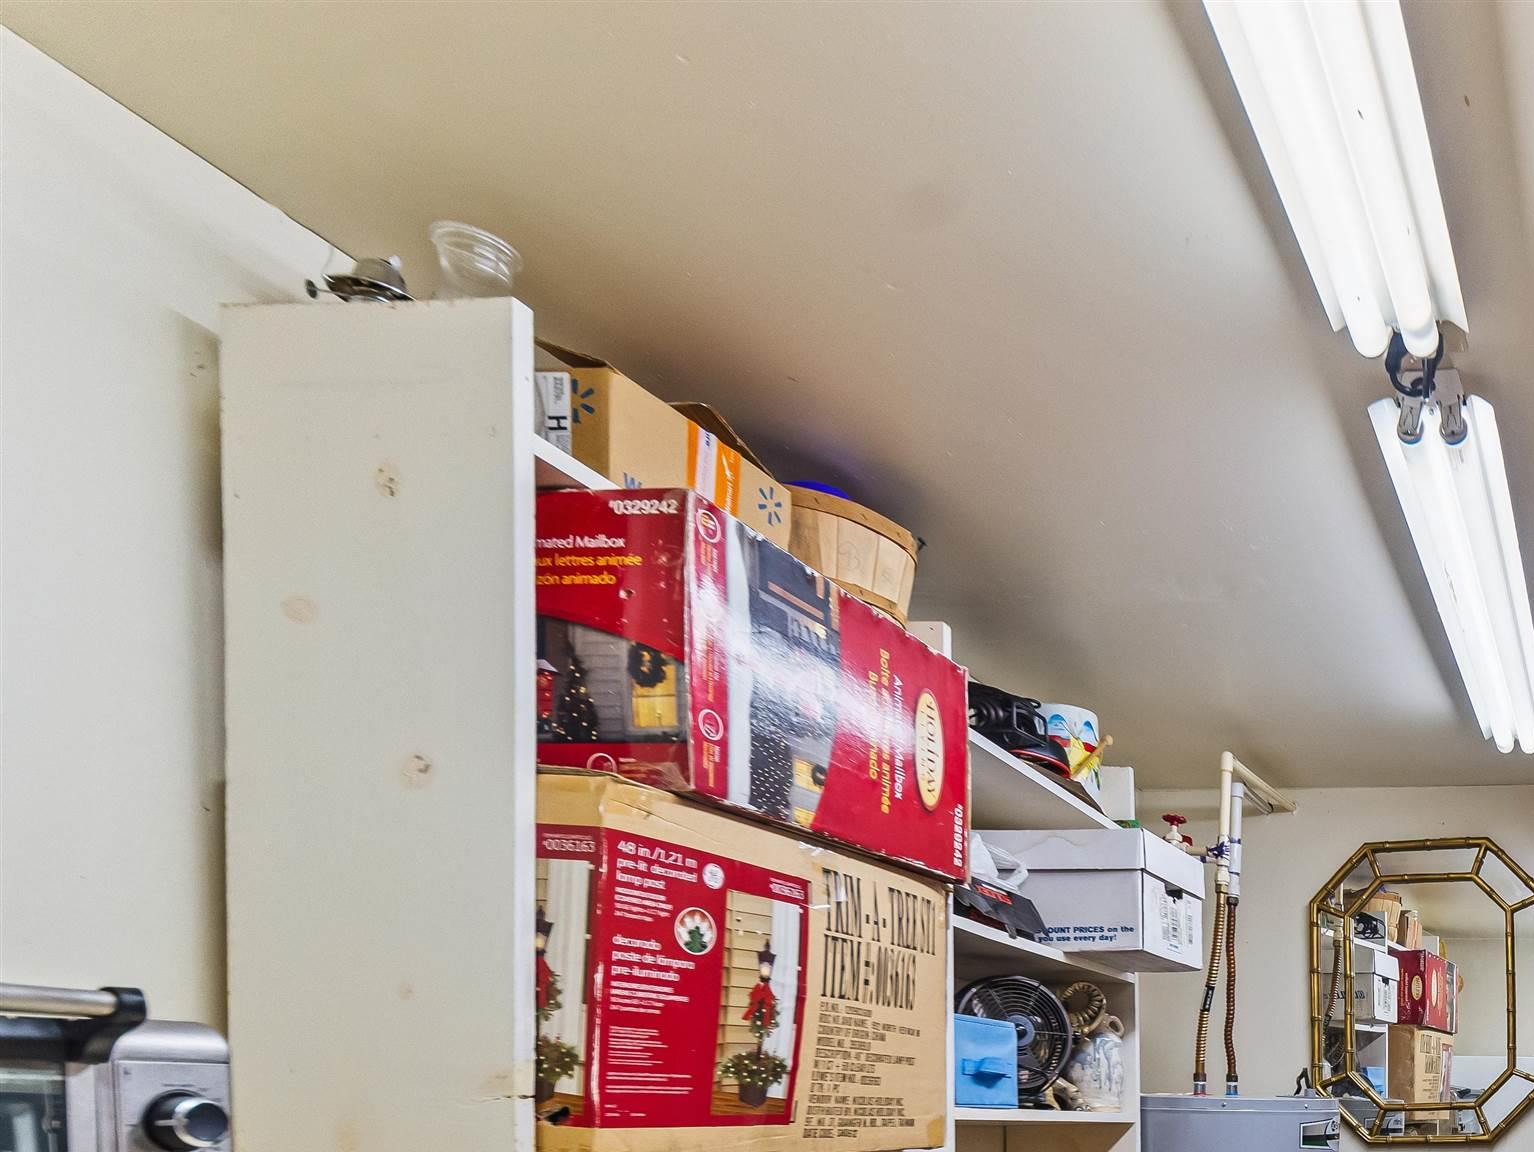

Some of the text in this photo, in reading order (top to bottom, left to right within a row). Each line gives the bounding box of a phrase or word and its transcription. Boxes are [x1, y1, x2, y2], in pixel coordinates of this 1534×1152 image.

[575, 534, 626, 549] Mailbox
[554, 554, 595, 567] lettres
[596, 554, 643, 569] animée
[561, 571, 617, 586] animado
[893, 750, 907, 801] Mailbox
[1073, 926, 1104, 934] PRICES
[1056, 934, 1071, 942] use
[1073, 934, 1096, 944] every
[1099, 932, 1117, 943] day!
[820, 933, 862, 1002] ITEM
